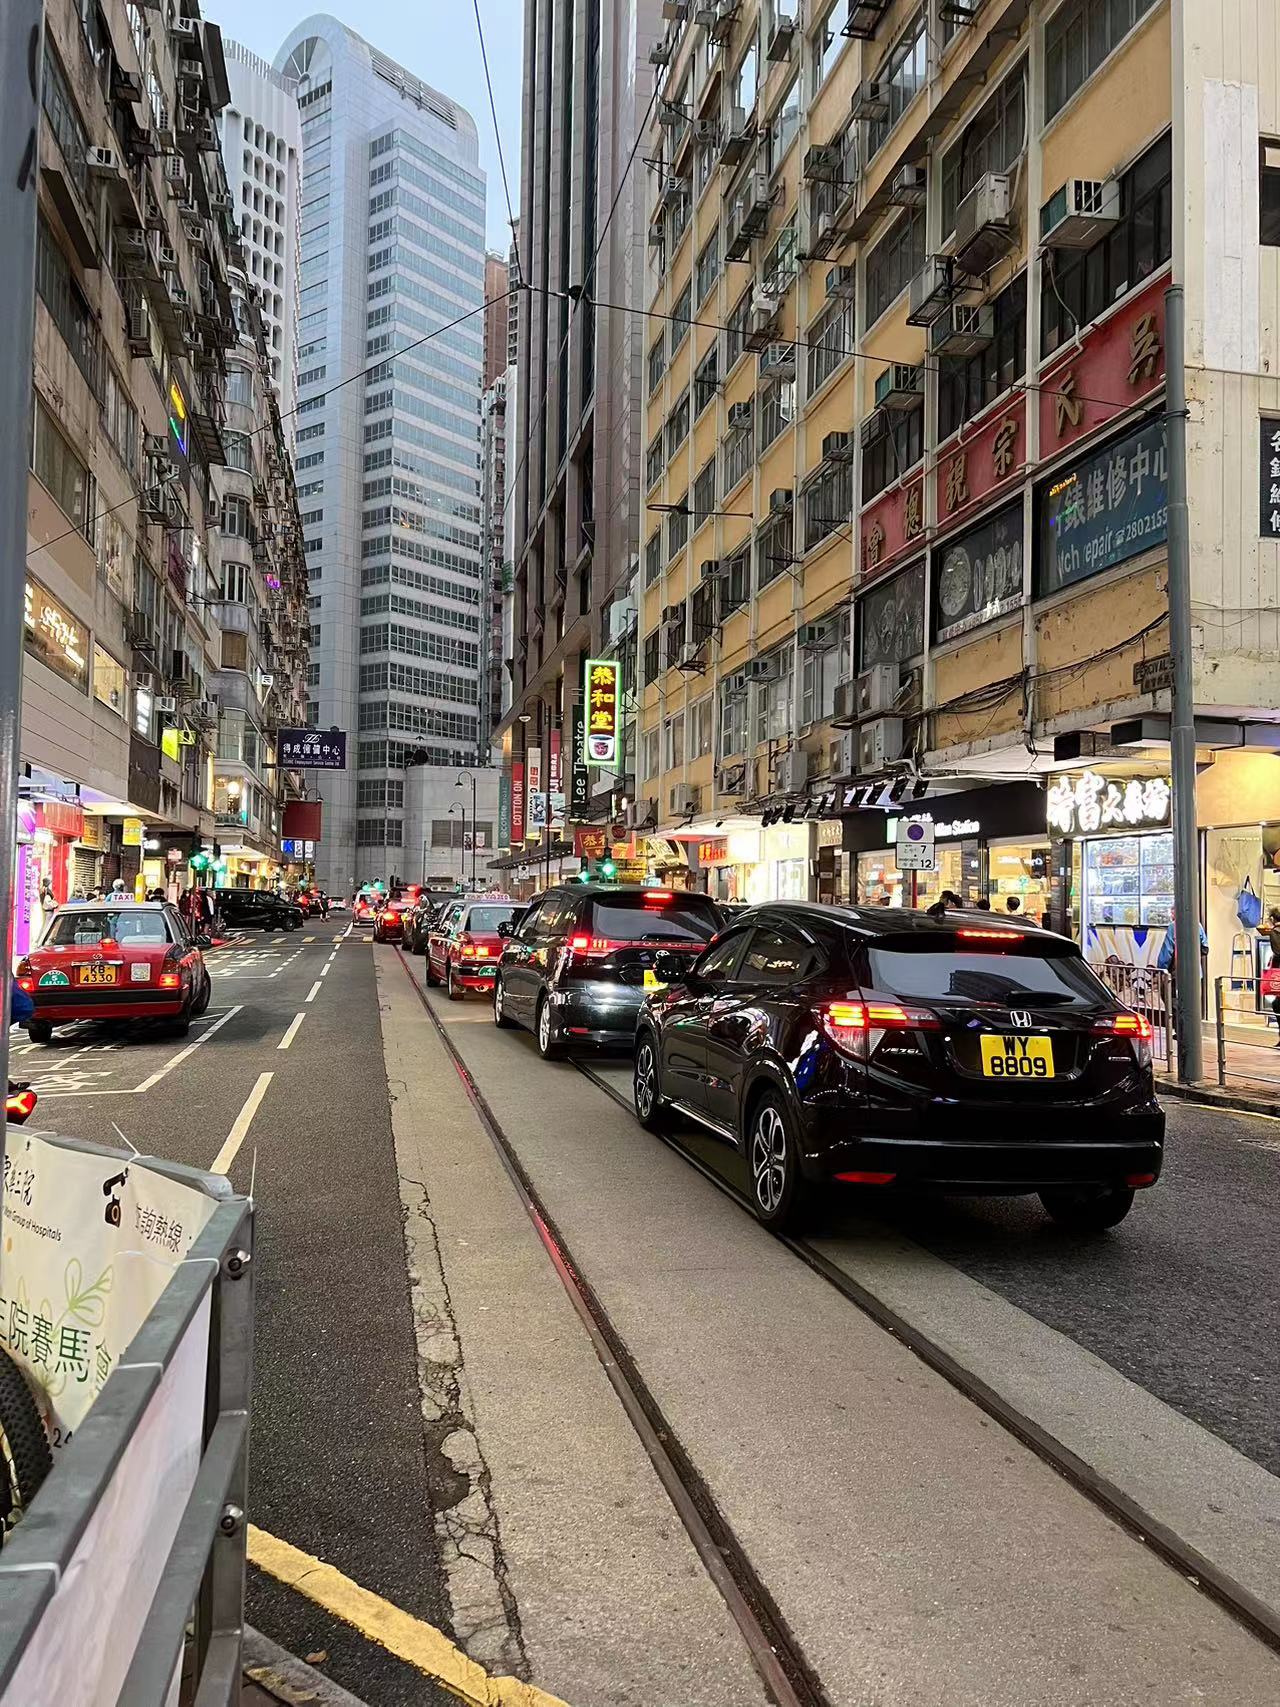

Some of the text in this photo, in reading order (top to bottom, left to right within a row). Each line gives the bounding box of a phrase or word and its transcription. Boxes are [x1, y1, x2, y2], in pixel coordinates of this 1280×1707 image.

[1125, 505, 1168, 542] 2802155
[590, 666, 615, 730] 恭和堂
[573, 720, 588, 804] Lee Theatre
[513, 780, 522, 826] COTTON ON
[920, 845, 926, 854] 7
[920, 859, 932, 868] 12
[83, 974, 112, 982] 4330
[90, 965, 105, 974] KB
[881, 1047, 923, 1056] VEZEL
[1003, 1036, 1029, 1056] WY
[990, 1056, 1047, 1077] 8809
[31, 1221, 61, 1242] Hospitals
[136, 1203, 183, 1253] 詢熱線
